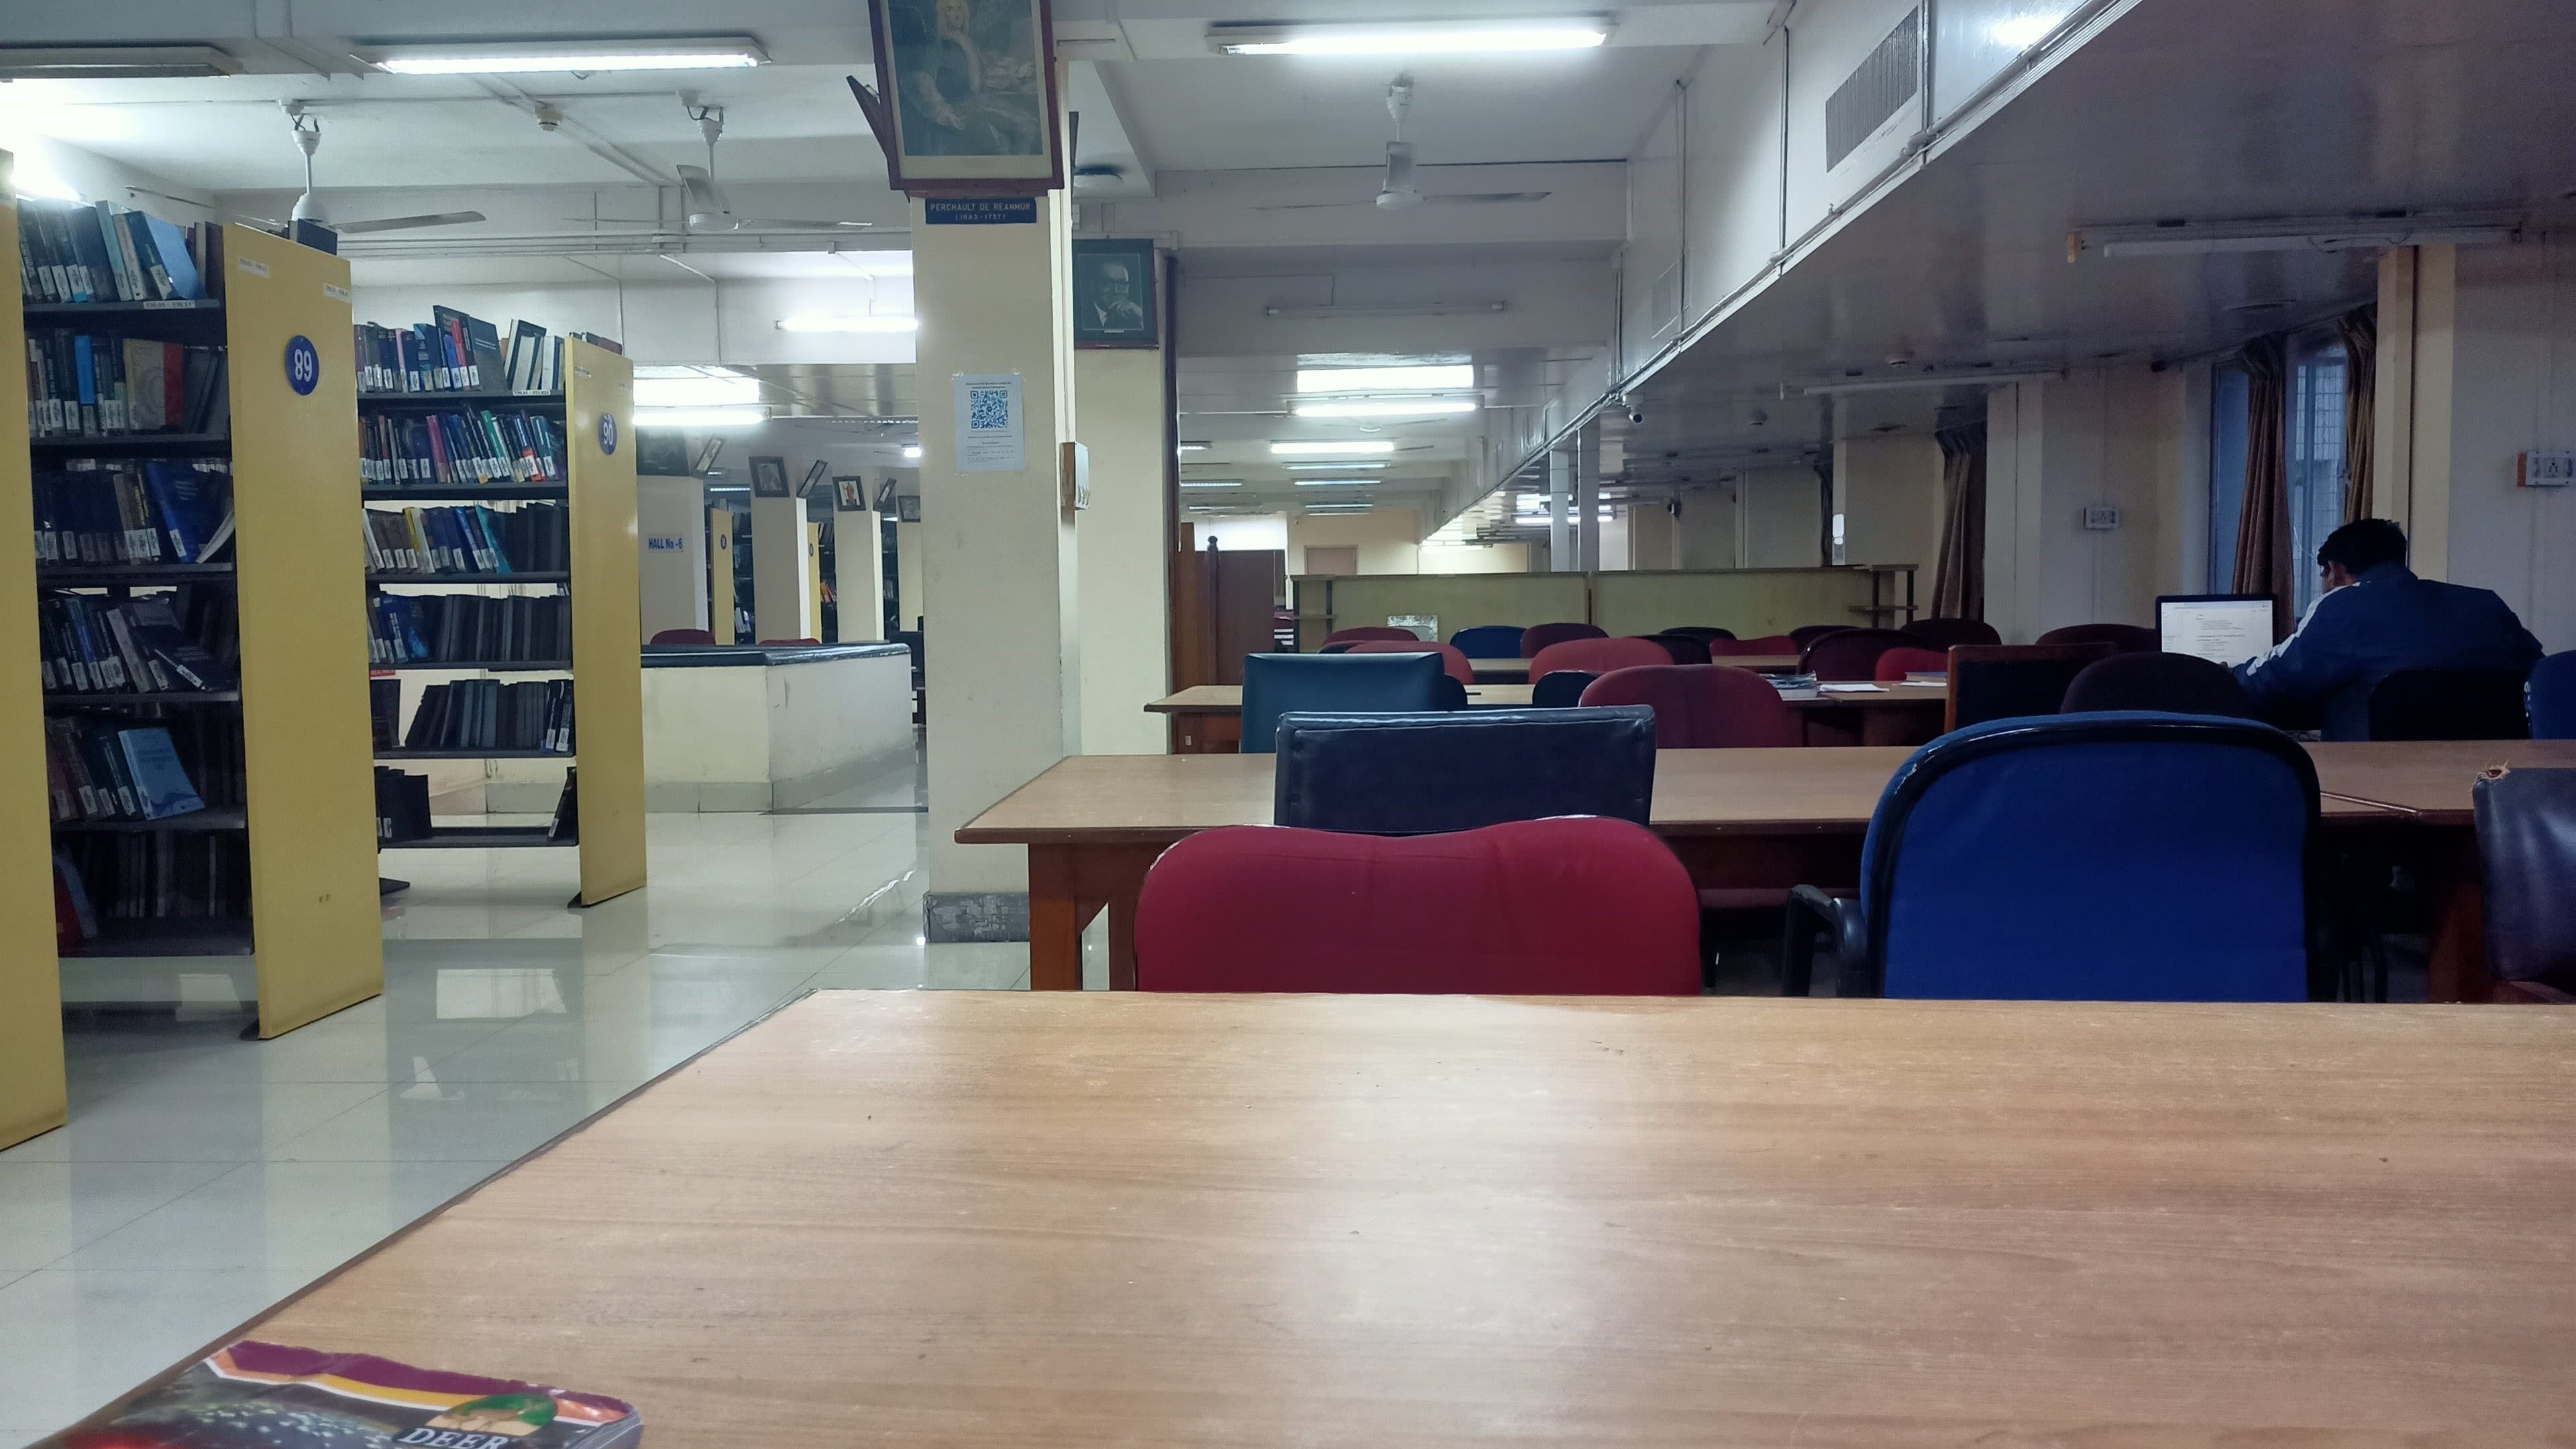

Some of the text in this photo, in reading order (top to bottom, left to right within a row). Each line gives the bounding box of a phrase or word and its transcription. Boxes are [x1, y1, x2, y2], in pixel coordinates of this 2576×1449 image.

[930, 203, 975, 211] PERCHAULT
[979, 203, 989, 211] DE
[294, 348, 313, 382] 89
[603, 422, 613, 446] 90
[649, 537, 665, 549] HALL
[397, 1428, 510, 1449] DEER
